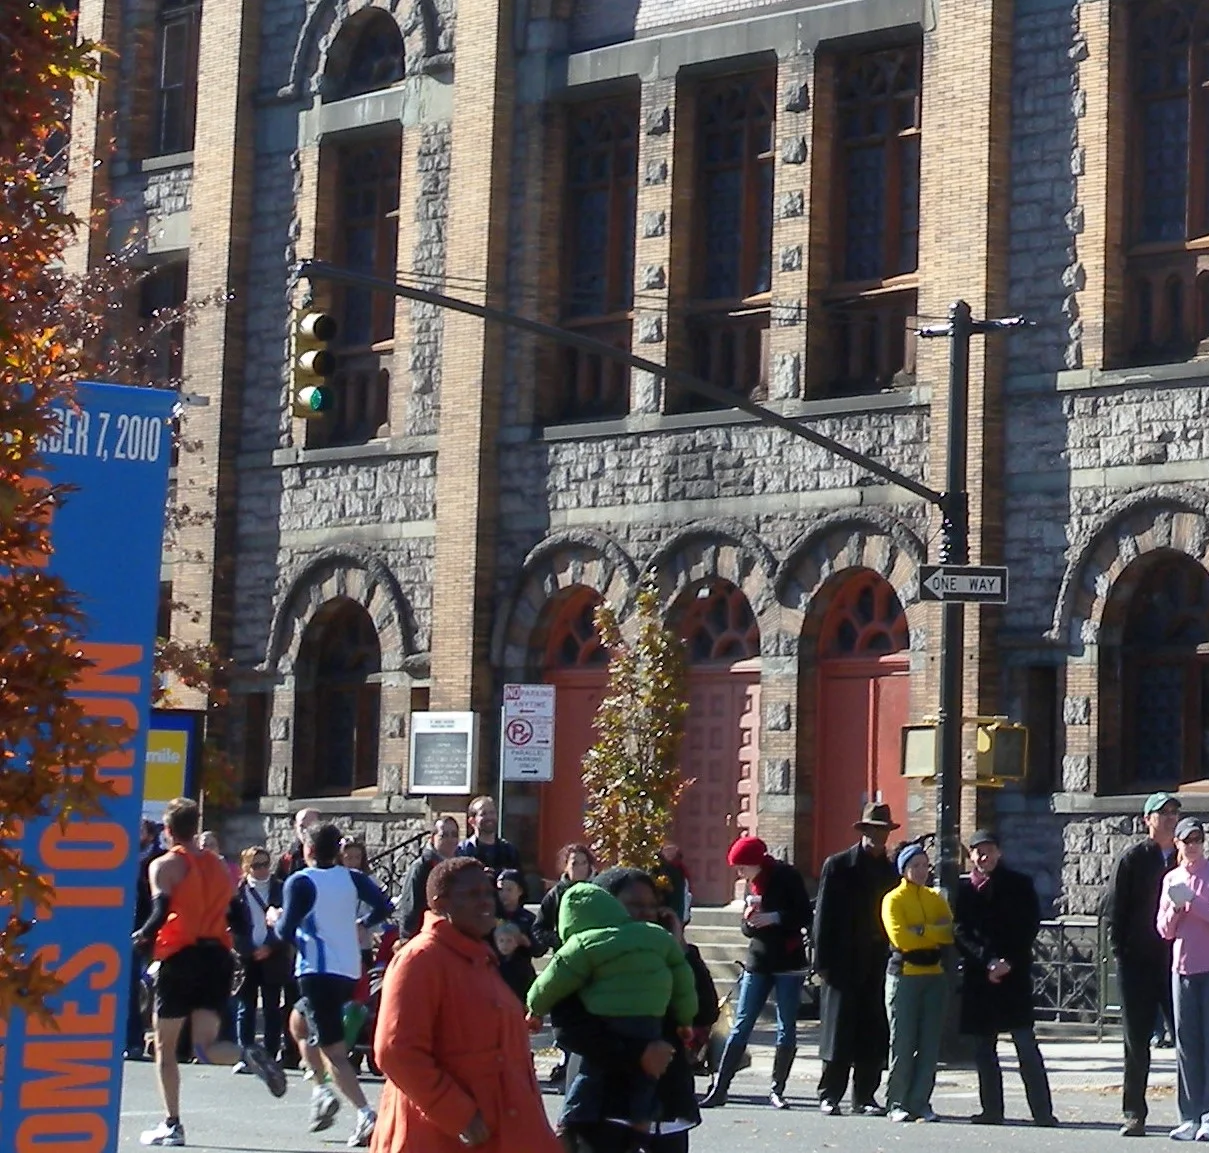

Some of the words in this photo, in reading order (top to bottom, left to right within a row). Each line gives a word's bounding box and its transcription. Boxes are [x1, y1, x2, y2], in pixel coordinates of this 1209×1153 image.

[36, 409, 90, 456] BER
[94, 412, 110, 461] 7,
[115, 414, 162, 462] 2010
[932, 577, 957, 591] ONE
[968, 578, 995, 591] WAY
[506, 687, 519, 698] NO
[521, 689, 552, 697] PARKING
[35, 821, 130, 920] TO
